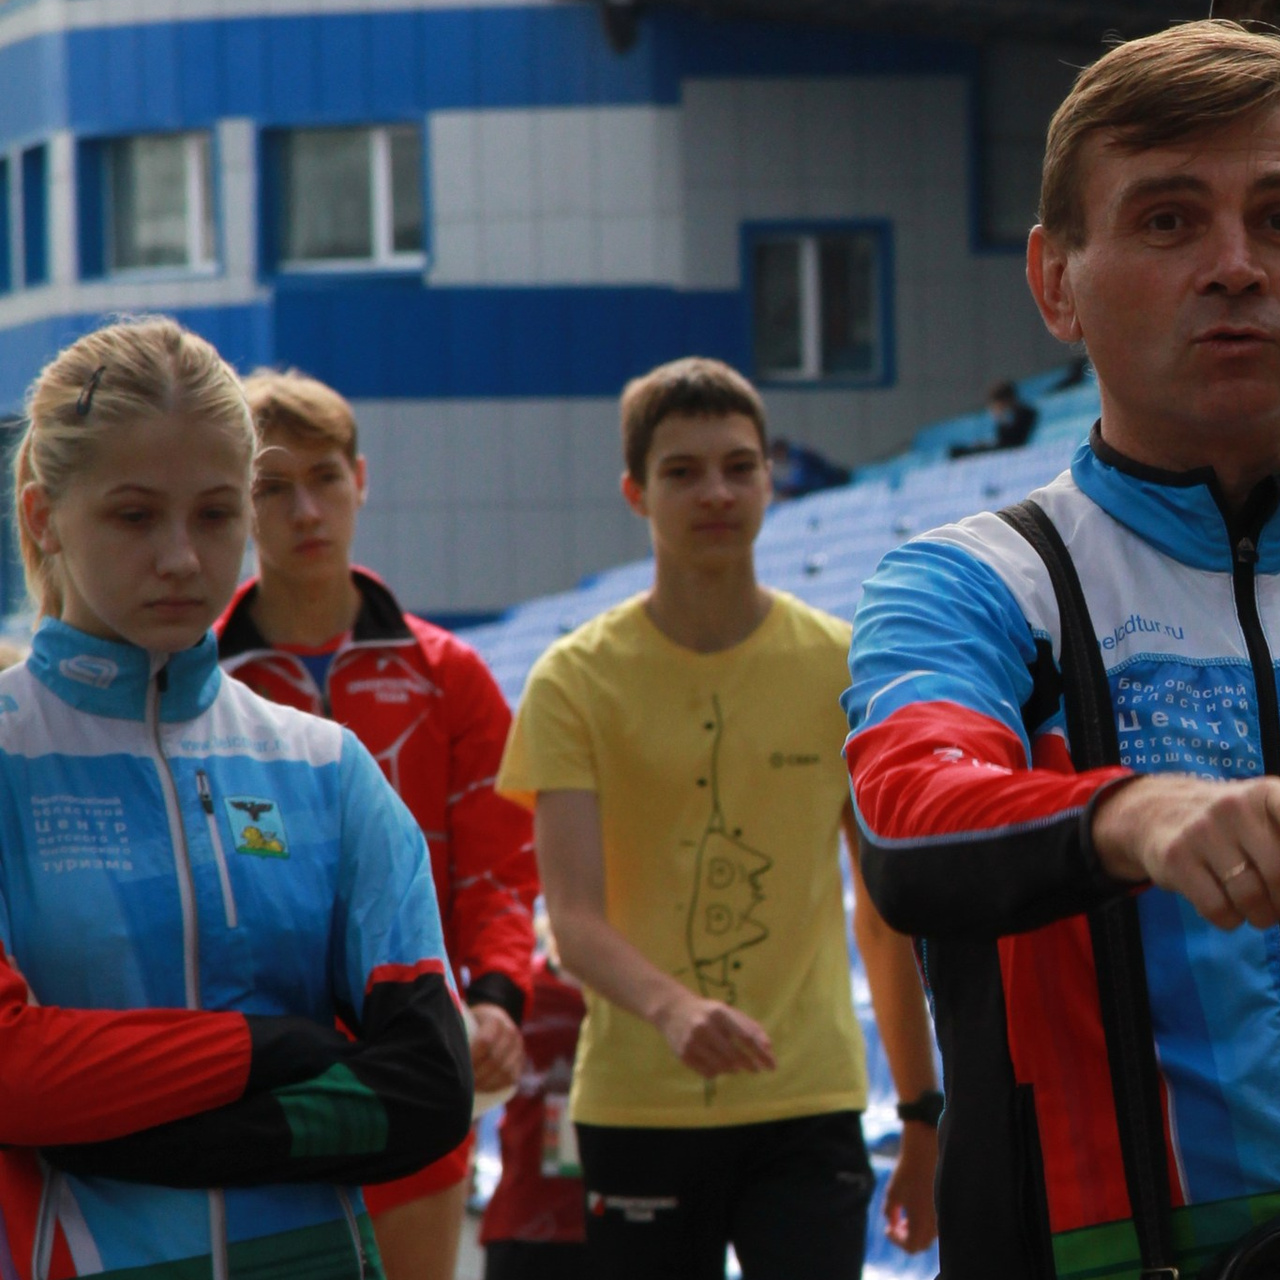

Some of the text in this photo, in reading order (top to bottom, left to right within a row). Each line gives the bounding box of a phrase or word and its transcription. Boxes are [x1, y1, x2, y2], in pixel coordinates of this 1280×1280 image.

[1098, 614, 1184, 651] elcdtur.ru
[1118, 677, 1247, 700] Белородский
[1117, 692, 1249, 713] областной
[1120, 752, 1256, 770] юношеского
[35, 818, 127, 834] Центр
